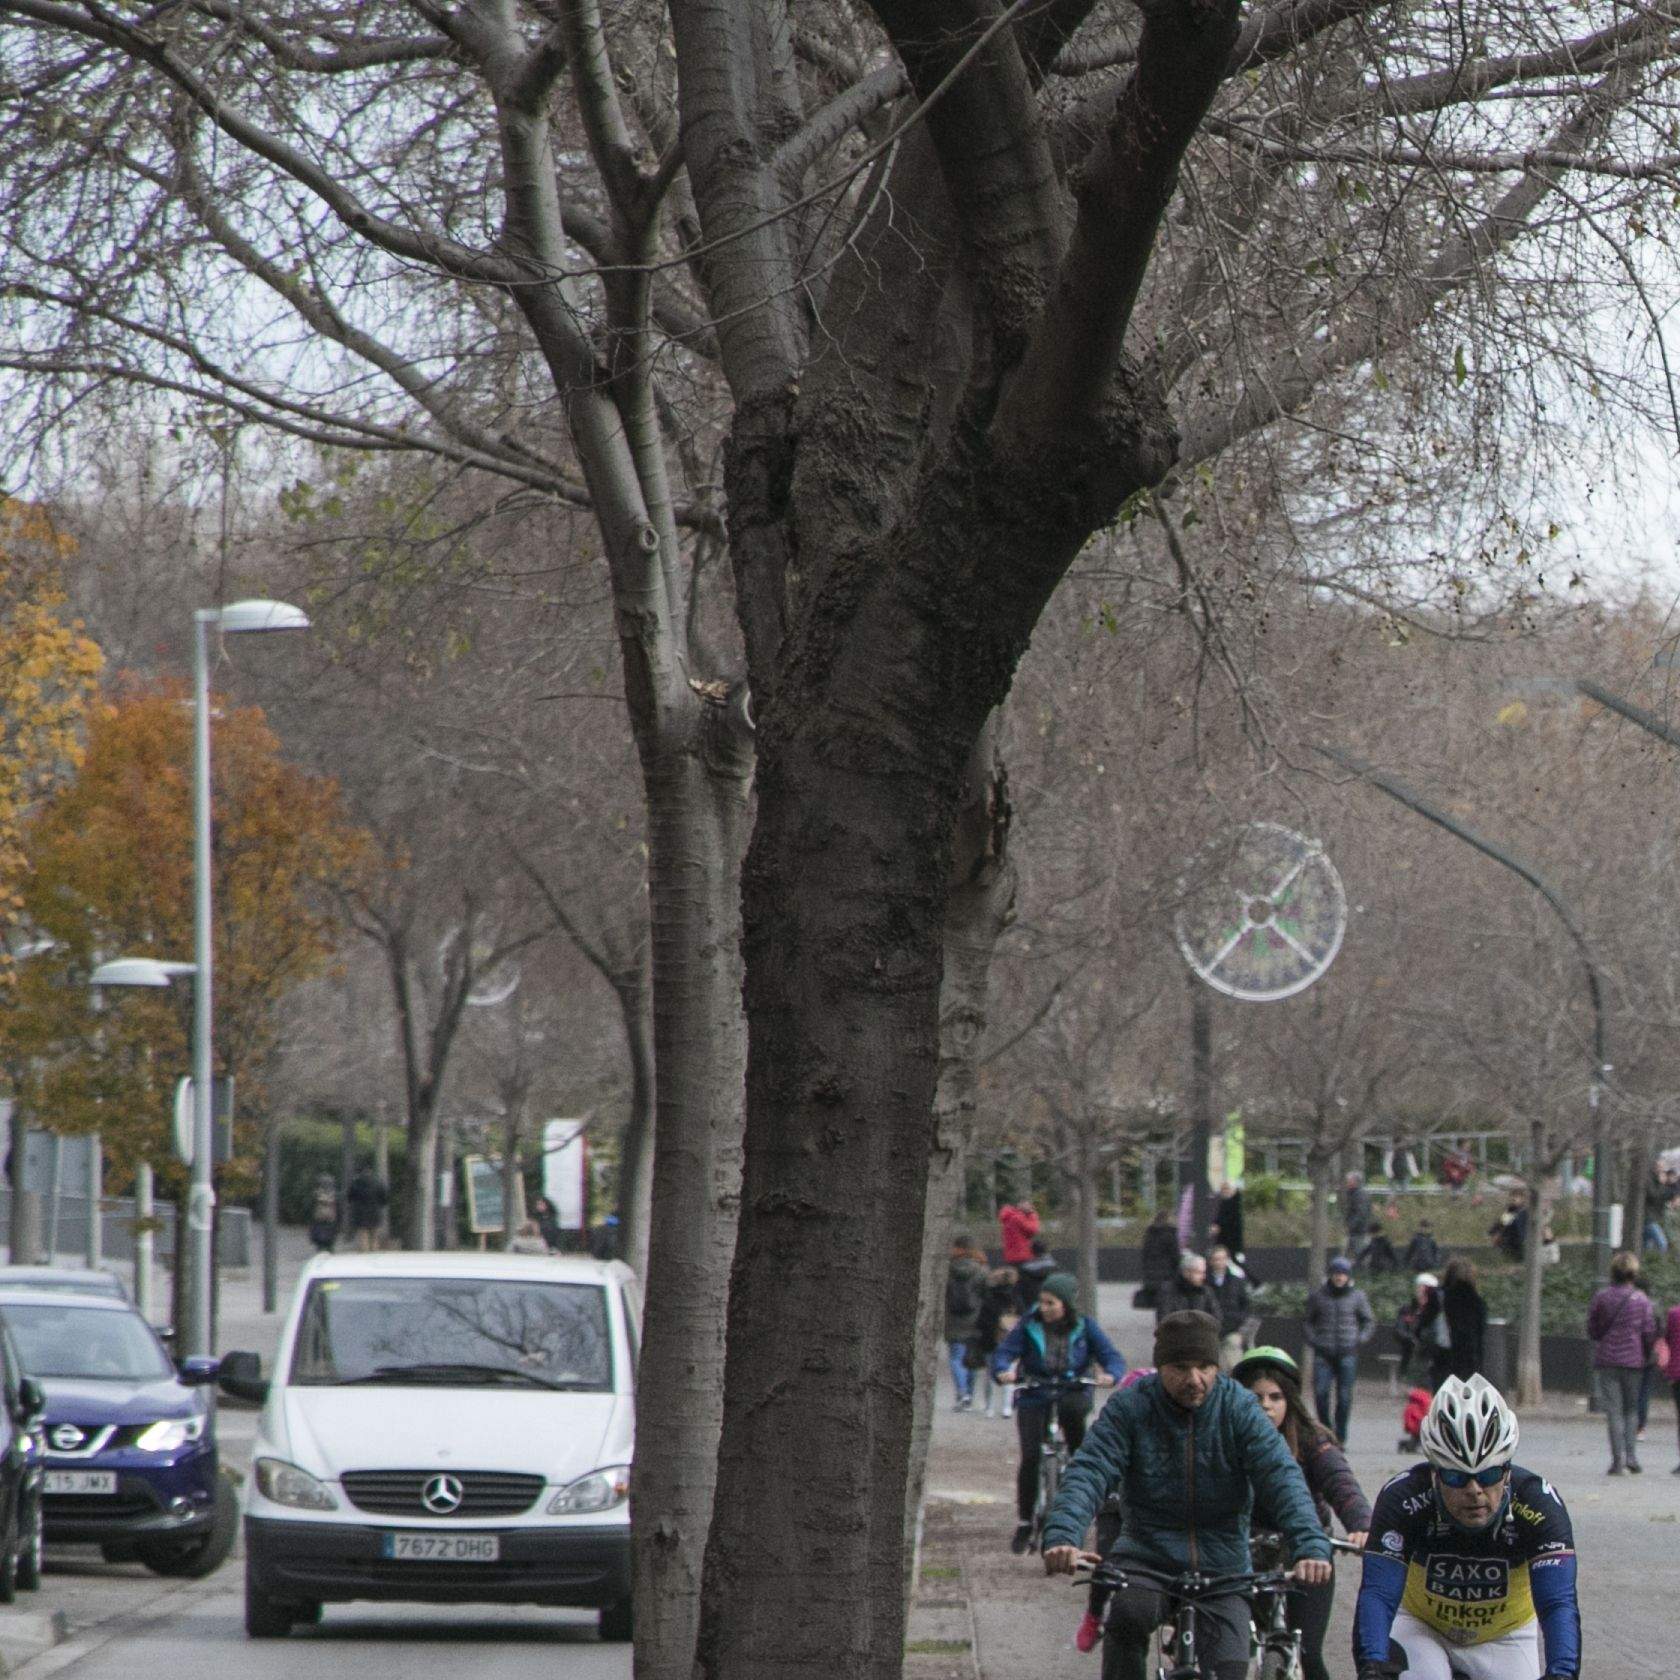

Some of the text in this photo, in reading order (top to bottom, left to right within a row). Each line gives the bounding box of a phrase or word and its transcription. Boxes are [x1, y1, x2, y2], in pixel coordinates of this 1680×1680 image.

[1511, 1492, 1546, 1526] inkoff
[399, 1538, 451, 1557] 7672
[1433, 1562, 1501, 1581] SAXO
[1431, 1581, 1502, 1599] BANK
